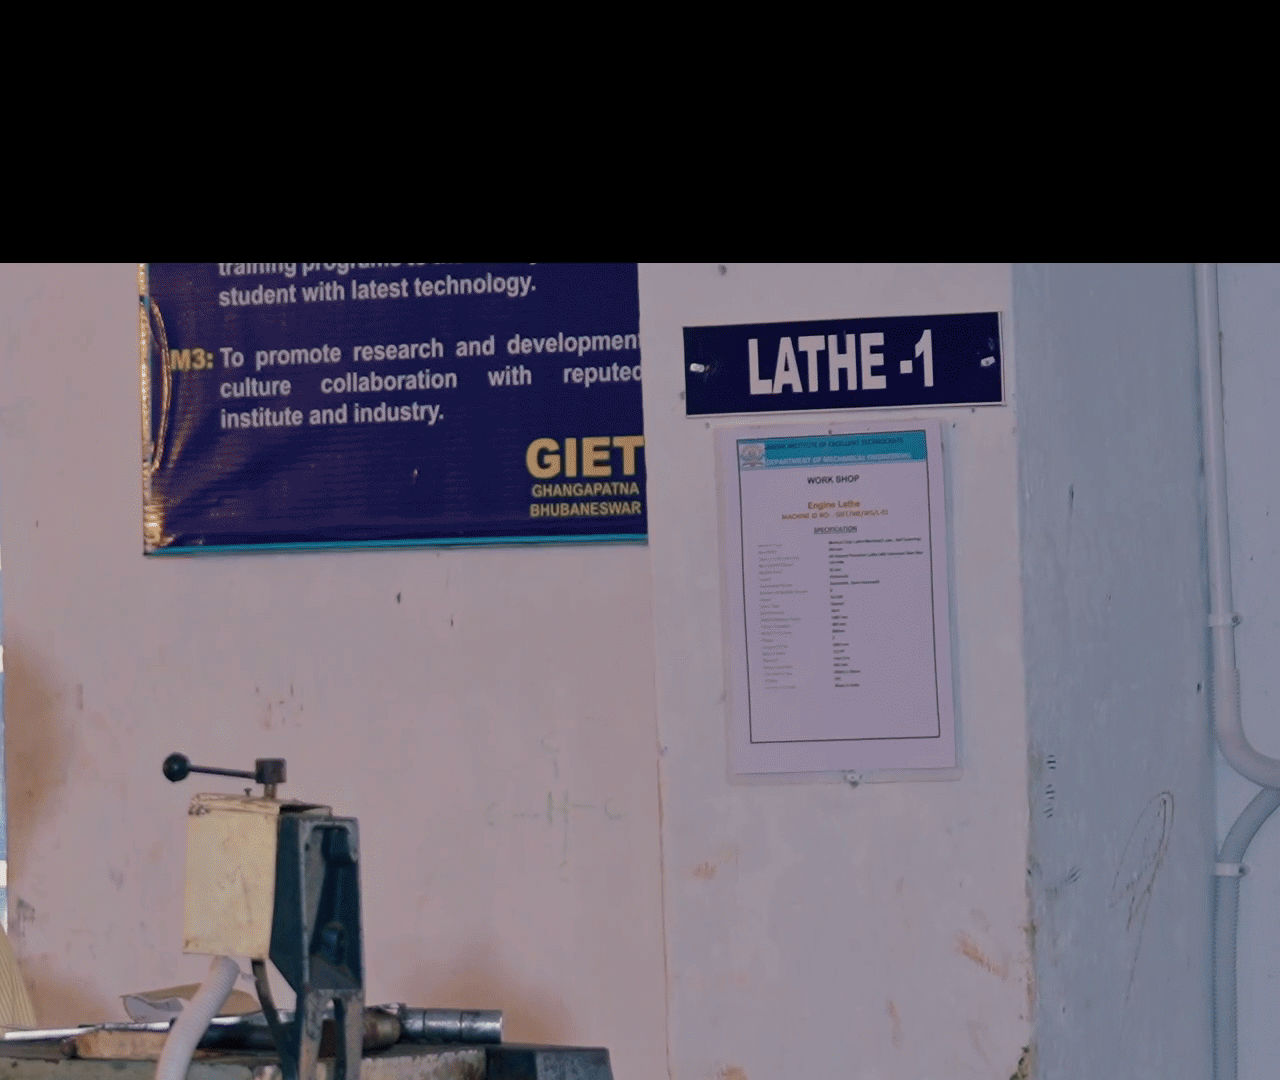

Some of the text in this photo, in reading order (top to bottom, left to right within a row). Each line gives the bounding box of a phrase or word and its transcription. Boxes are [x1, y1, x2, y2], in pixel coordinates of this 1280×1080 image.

[219, 273, 535, 306] student with latest technology.
[172, 348, 213, 371] M3:
[220, 347, 244, 367] To
[256, 344, 341, 371] promote
[354, 338, 443, 361] research
[456, 335, 494, 356] and
[748, 328, 934, 395] LATHE -1
[220, 377, 291, 398] culture
[321, 369, 457, 393] collaboration
[488, 365, 531, 386] with
[221, 402, 443, 428] institute and industry.
[526, 435, 646, 479] GIET
[532, 478, 639, 497] GHANGAPATNA
[836, 475, 859, 483] SHOP
[530, 501, 641, 517] BHUBANESWAR
[808, 502, 835, 510] Engine
